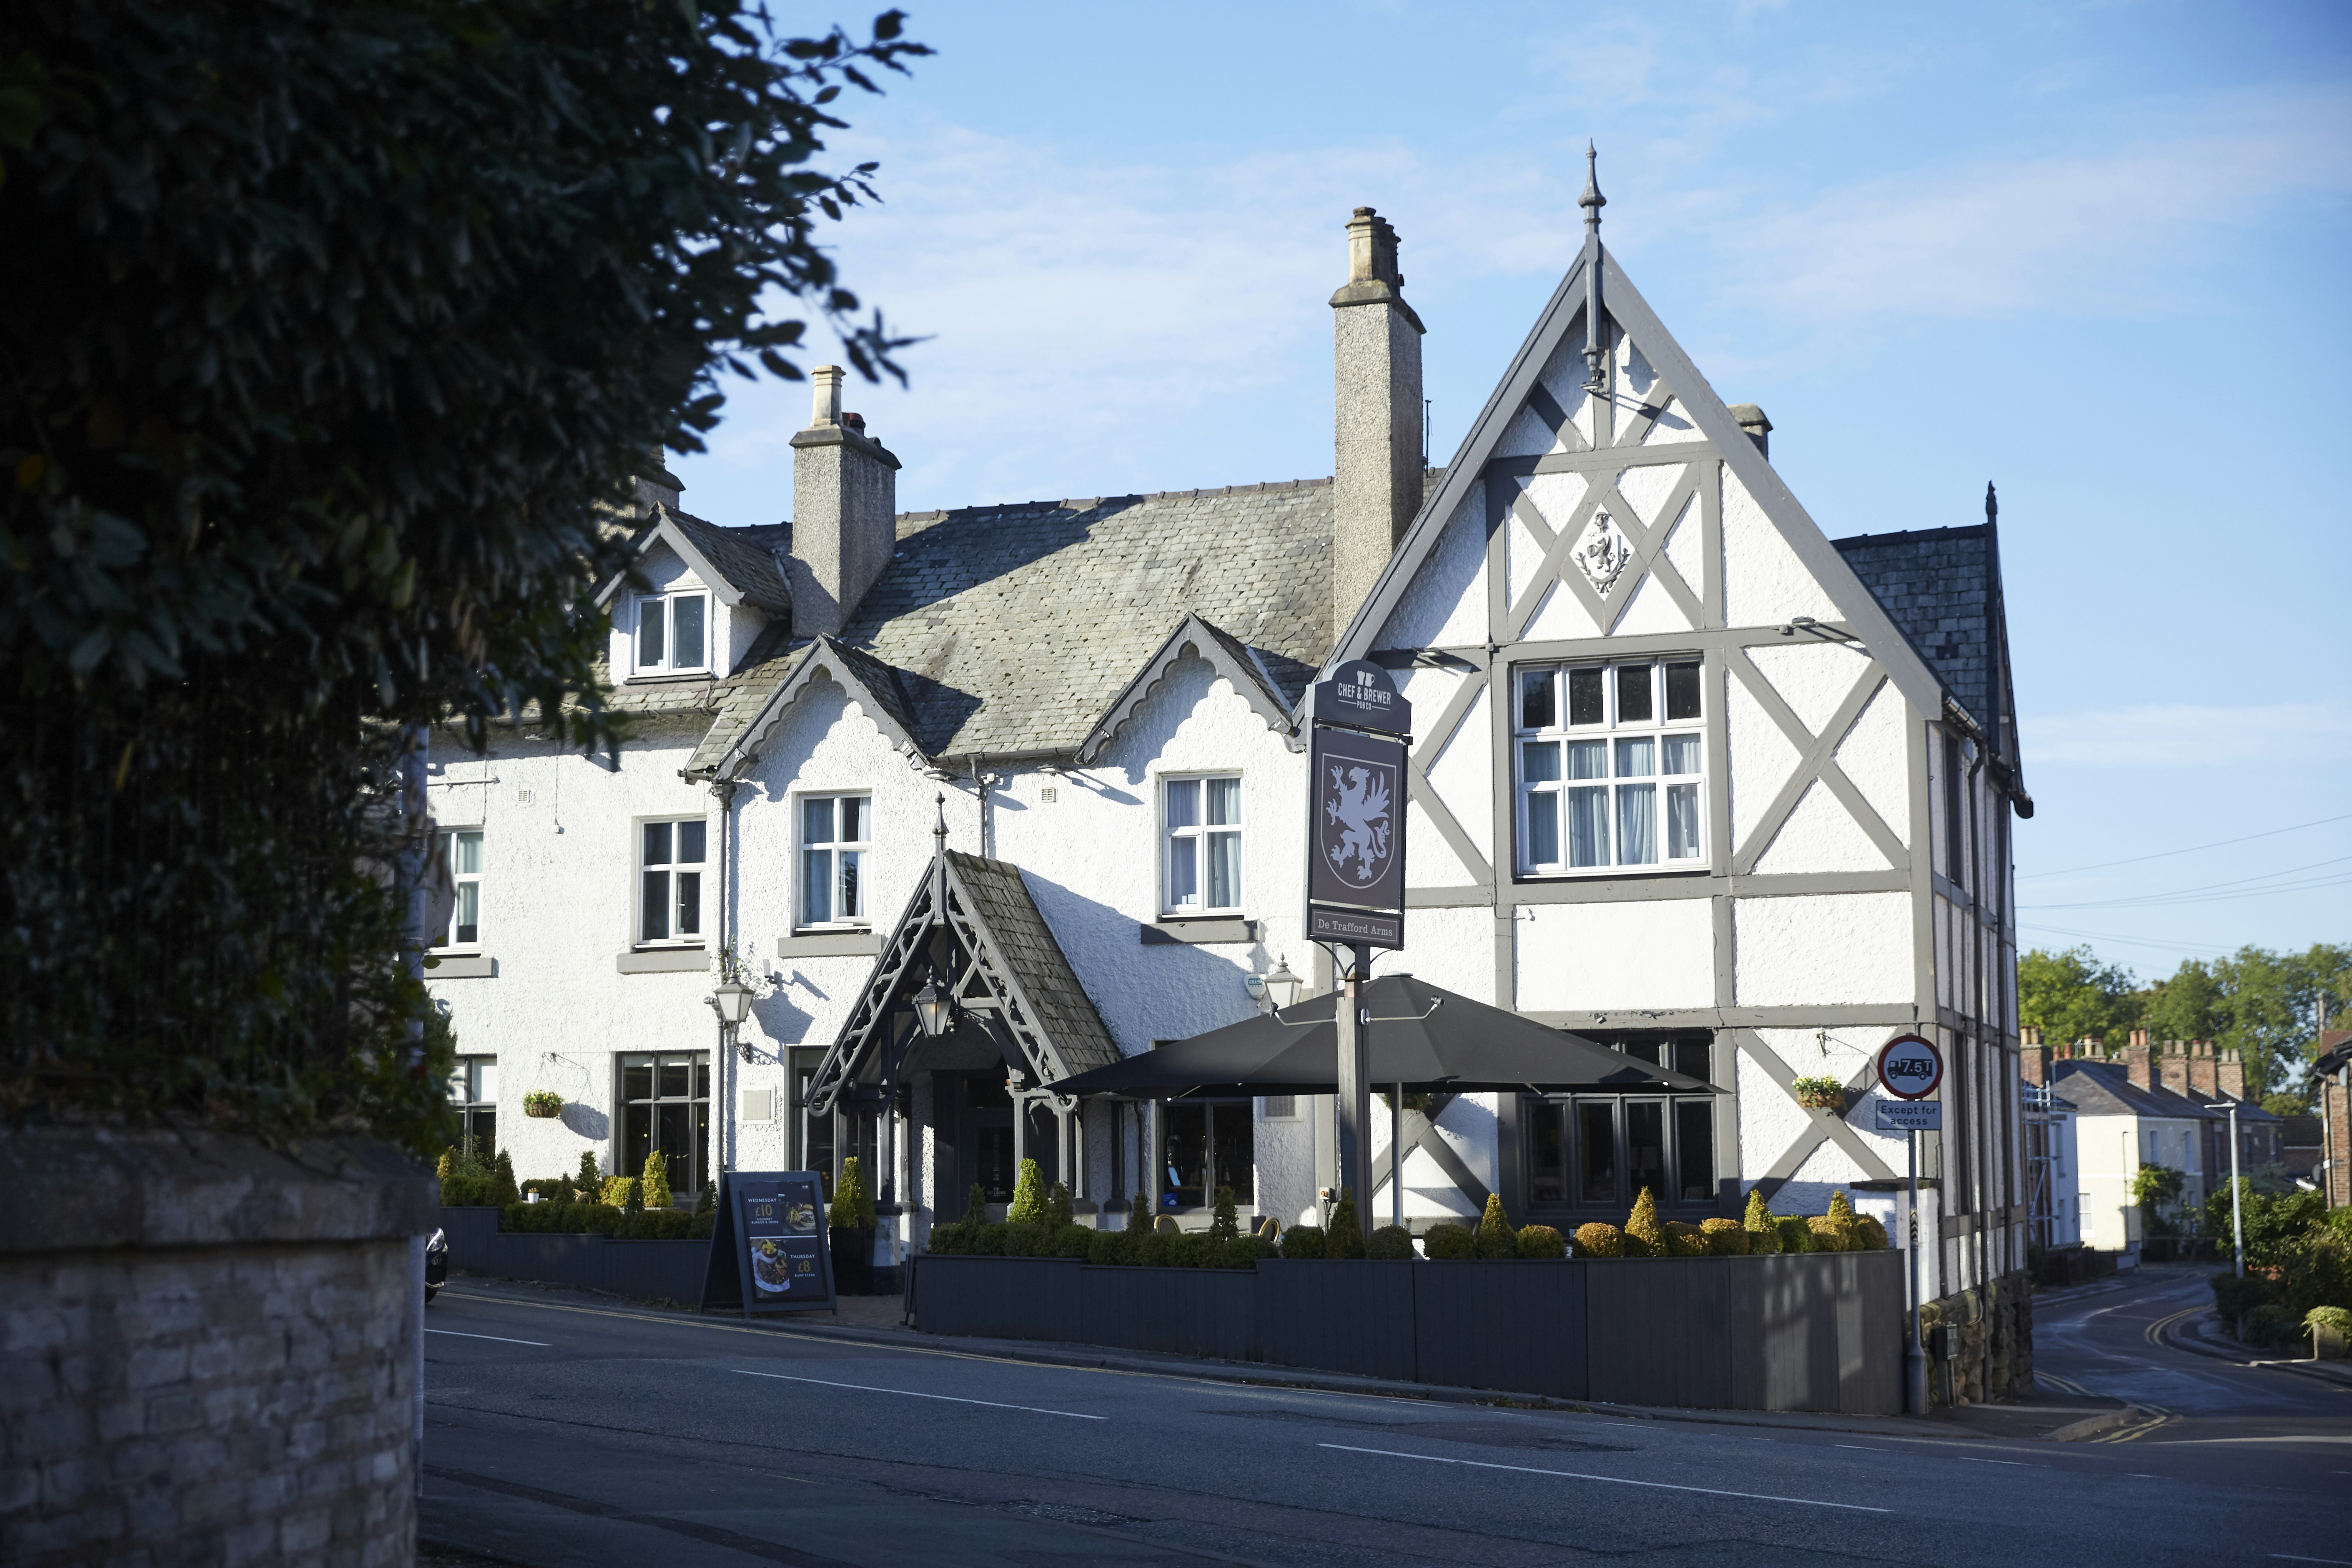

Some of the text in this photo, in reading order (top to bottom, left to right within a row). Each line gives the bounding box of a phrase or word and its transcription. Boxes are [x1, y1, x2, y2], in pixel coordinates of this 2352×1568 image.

[1338, 682, 1391, 705] CHEF & BREWER
[1357, 700, 1372, 710] PUB CO
[1318, 919, 1393, 936] De Trafford Arms
[1901, 1060, 1931, 1073] 7.5T
[1881, 1105, 1936, 1115] Except for
[755, 1204, 772, 1216] £10
[798, 1260, 810, 1272] £8
